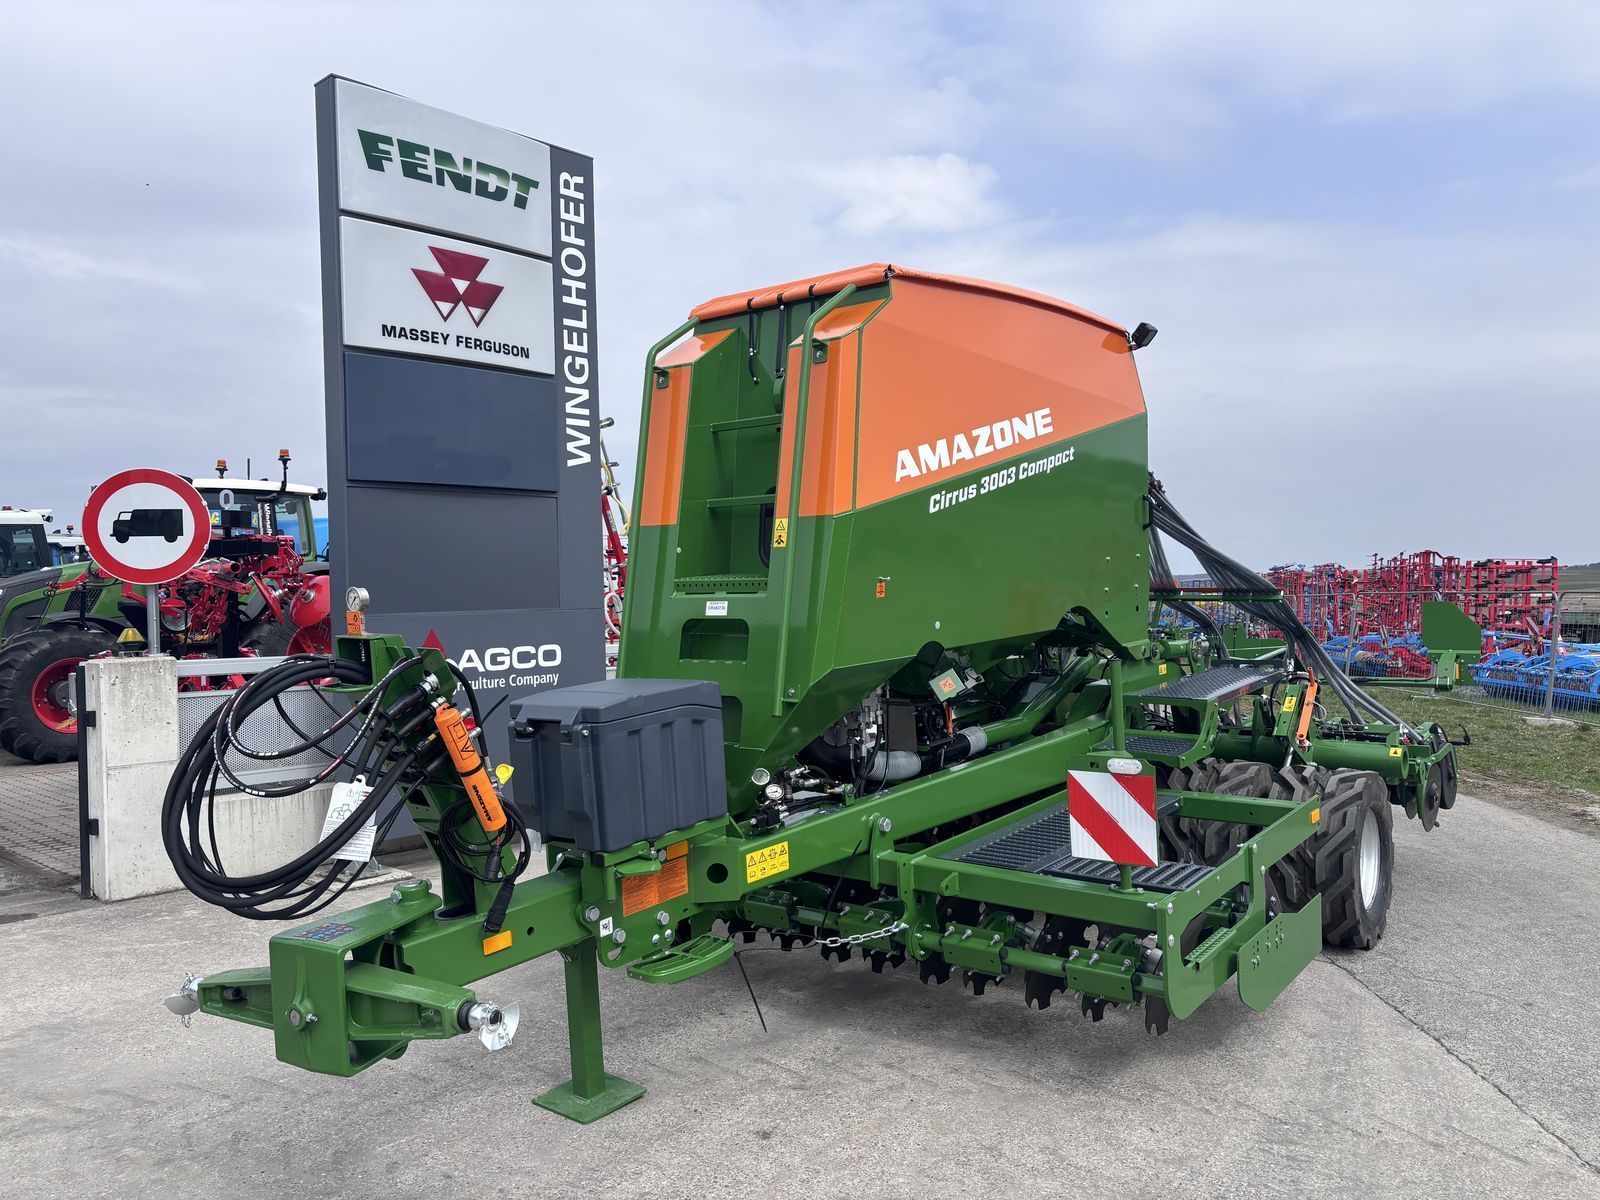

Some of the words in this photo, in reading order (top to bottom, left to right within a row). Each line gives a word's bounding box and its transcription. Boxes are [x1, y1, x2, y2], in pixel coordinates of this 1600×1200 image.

[357, 128, 540, 210] FENDT
[381, 323, 451, 346] MASSEY
[455, 335, 530, 360] FERGUSON
[558, 170, 591, 467] WINGELHOFER
[894, 406, 1054, 483] AMAZONE
[928, 483, 977, 514] Cirrus
[980, 466, 1016, 495] 3003
[1018, 446, 1075, 480] Compact
[458, 643, 562, 673] AGCO
[508, 673, 560, 688] Company
